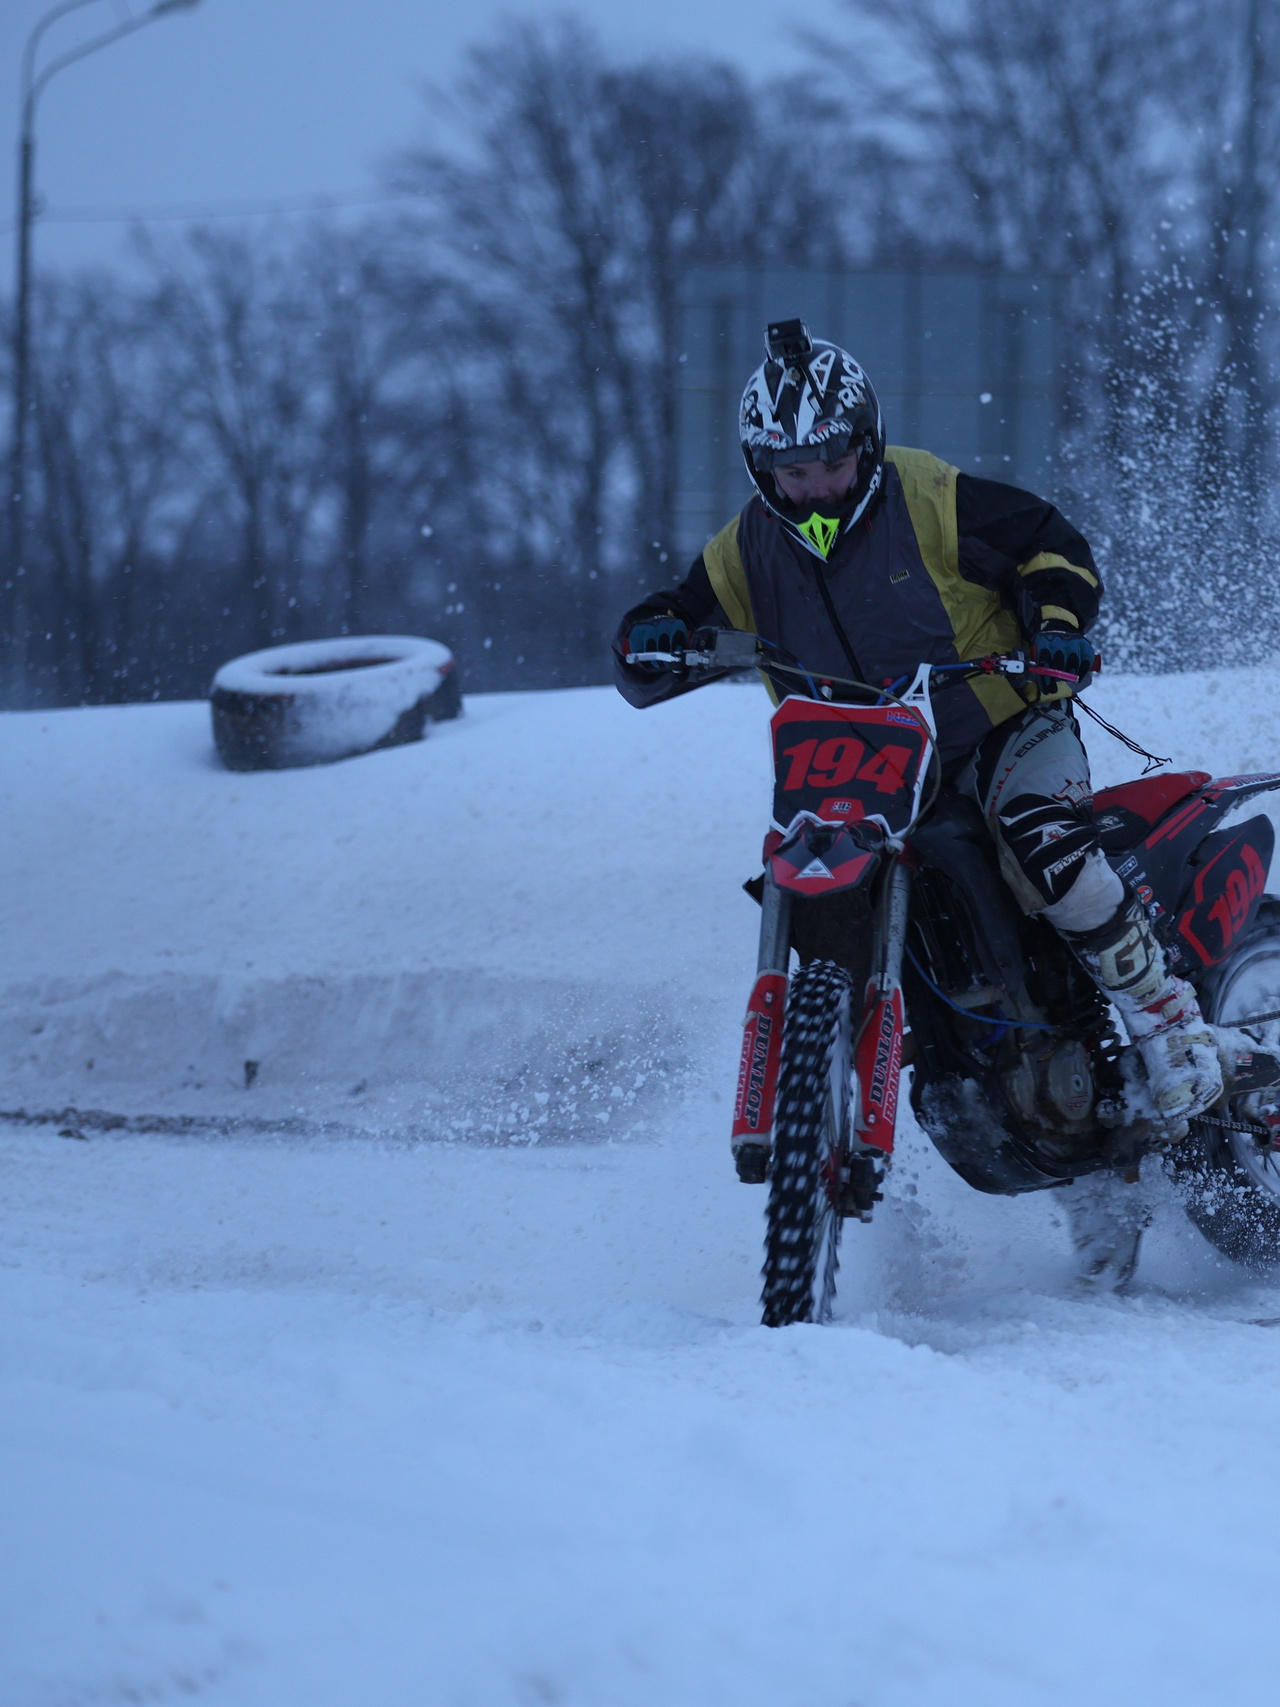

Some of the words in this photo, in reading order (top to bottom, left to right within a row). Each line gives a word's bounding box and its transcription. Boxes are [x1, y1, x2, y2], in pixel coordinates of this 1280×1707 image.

[782, 736, 913, 796] 194
[1015, 718, 1067, 758] EQUIPMENT
[1207, 843, 1266, 950] 194
[744, 1011, 773, 1129] DUNLOP
[869, 1001, 897, 1108] DUNLOP
